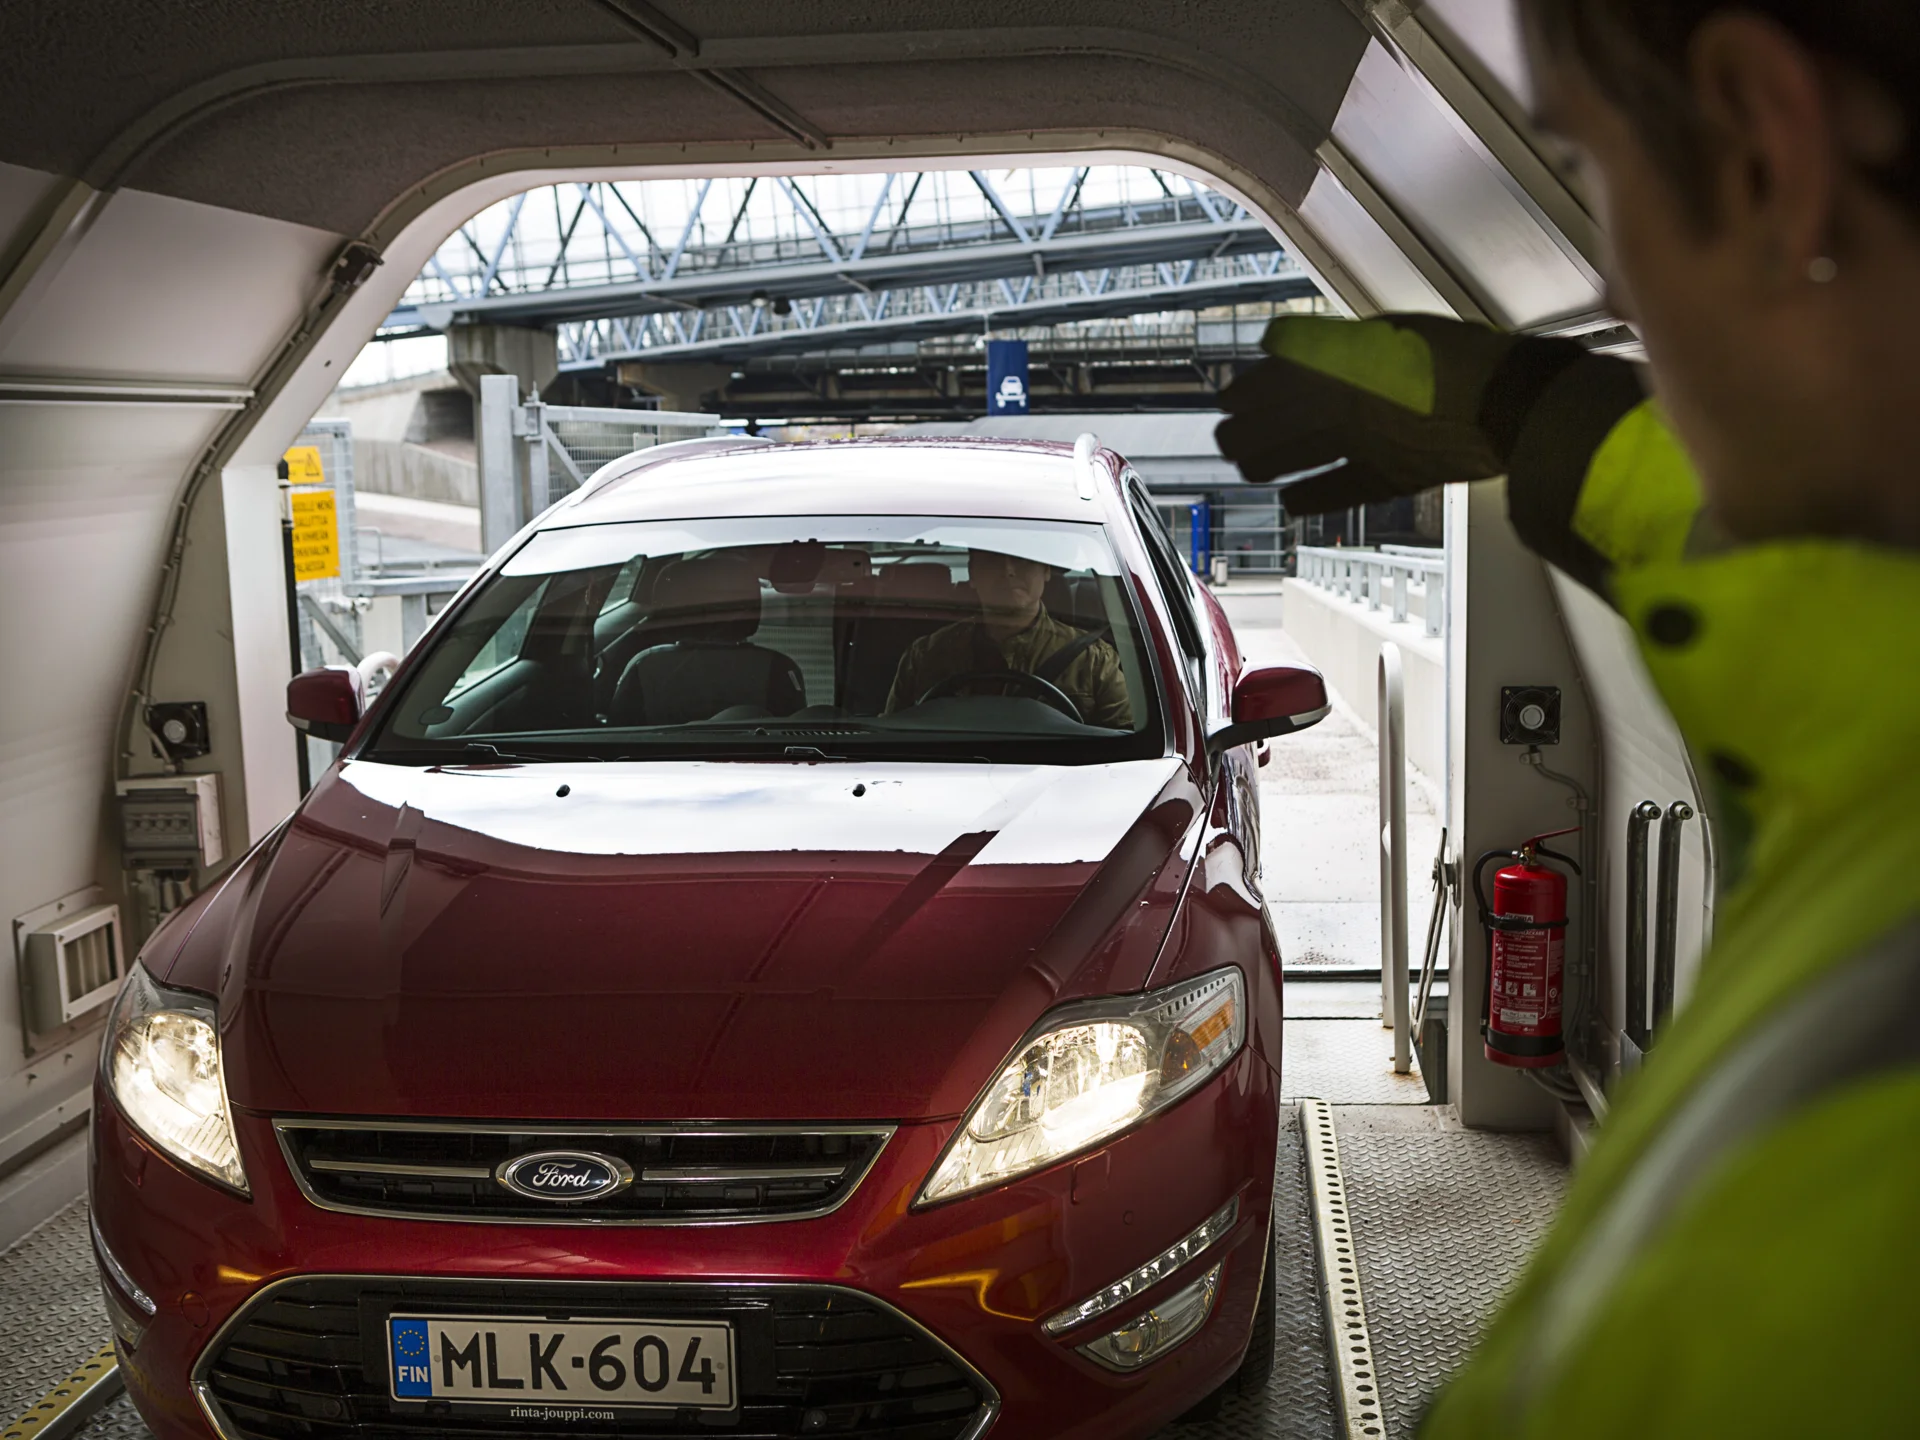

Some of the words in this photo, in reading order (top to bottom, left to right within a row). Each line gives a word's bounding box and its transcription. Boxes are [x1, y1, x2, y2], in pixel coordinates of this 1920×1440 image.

[532, 1162, 591, 1187] Ford
[398, 1365, 429, 1383] FIN
[440, 1330, 716, 1395] MLK-604
[510, 1406, 615, 1421] rinta-jouppi.com
